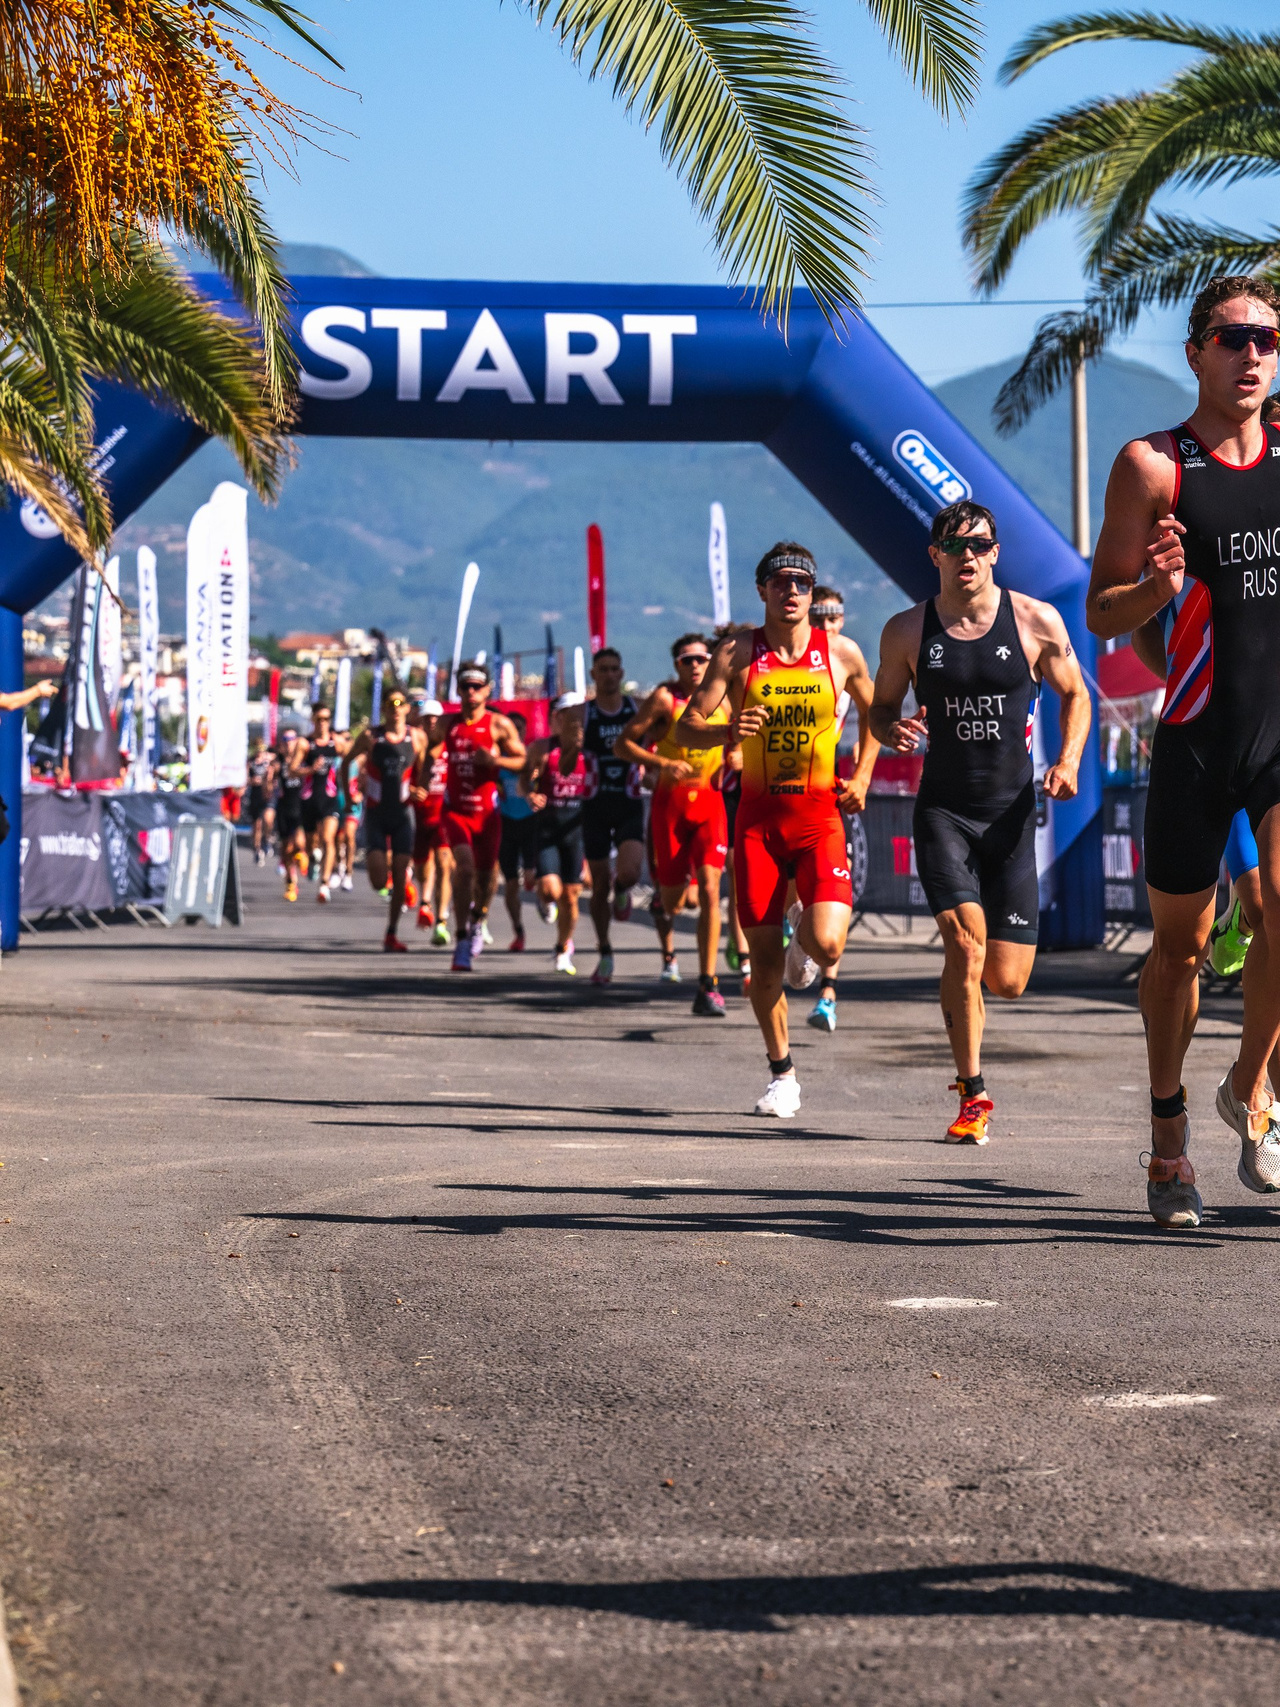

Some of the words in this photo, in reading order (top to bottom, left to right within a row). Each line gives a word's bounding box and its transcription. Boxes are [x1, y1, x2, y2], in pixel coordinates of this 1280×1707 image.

[300, 305, 697, 405] START
[900, 438, 965, 502] Oral-B
[1243, 567, 1278, 600] RUS
[775, 684, 821, 694] SUZUKI
[764, 698, 816, 728] GARCÍA
[944, 694, 1007, 717] HART
[767, 731, 810, 752] ESP
[956, 720, 1002, 741] GBR
